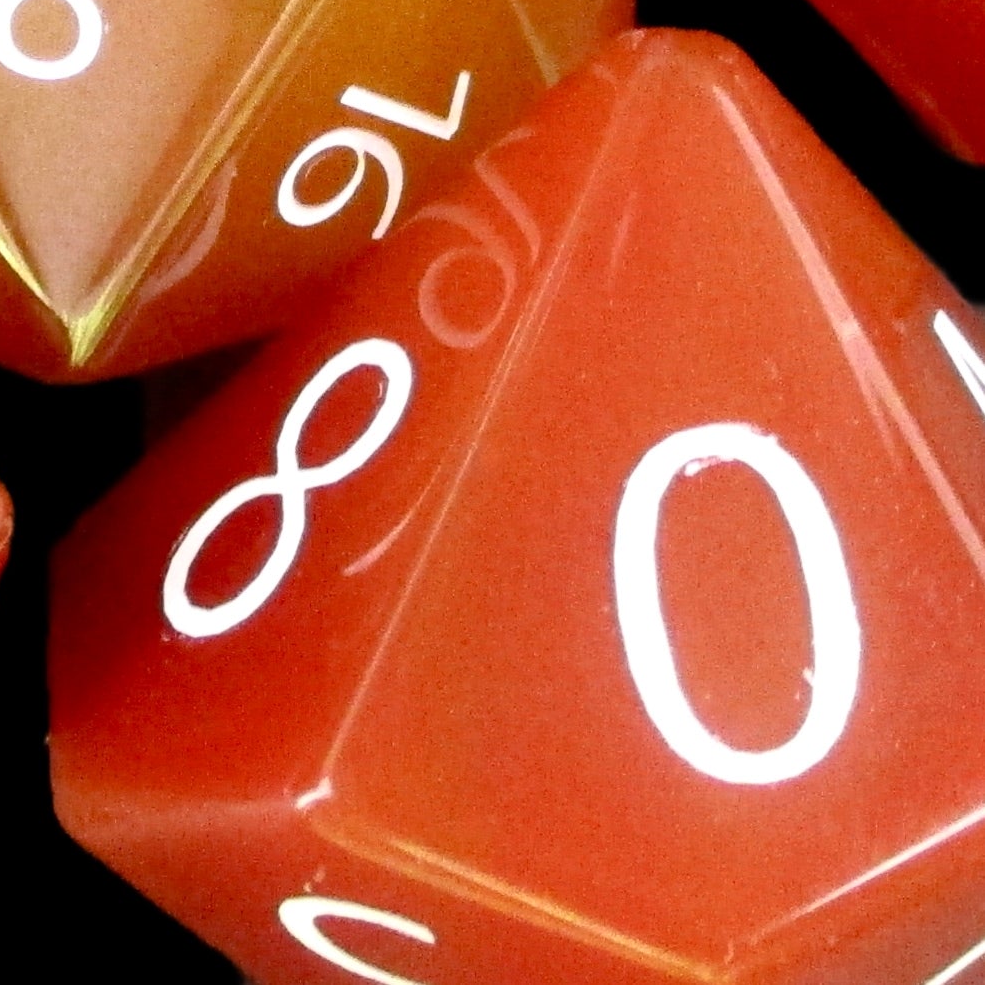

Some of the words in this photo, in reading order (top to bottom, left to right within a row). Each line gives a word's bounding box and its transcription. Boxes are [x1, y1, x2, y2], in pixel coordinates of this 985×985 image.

[276, 71, 472, 240] 16
[162, 337, 414, 639] 8
[612, 421, 864, 786] 0
